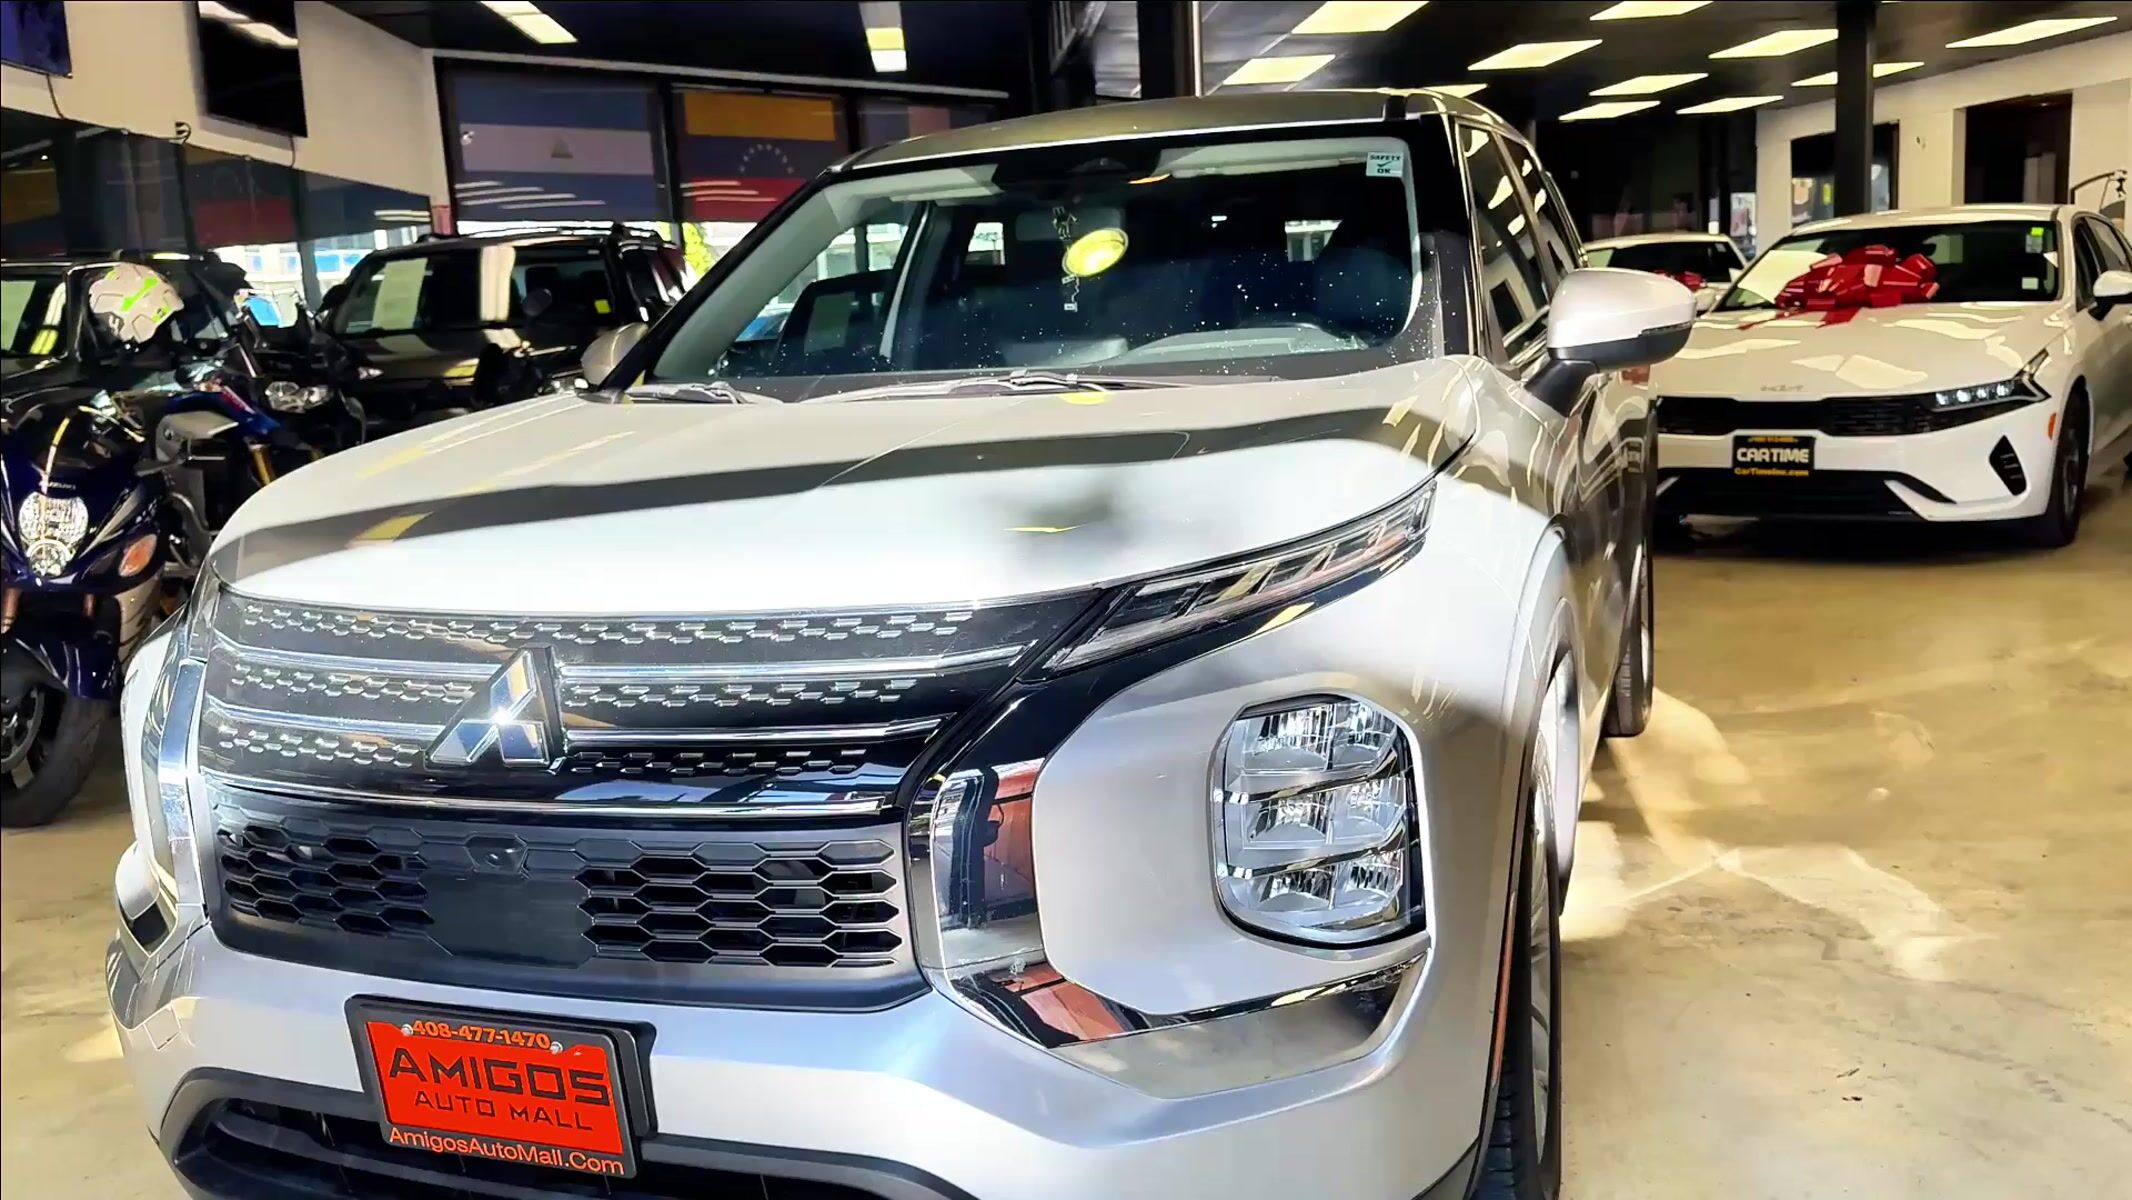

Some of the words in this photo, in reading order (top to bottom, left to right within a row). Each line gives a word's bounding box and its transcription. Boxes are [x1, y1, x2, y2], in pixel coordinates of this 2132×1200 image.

[1736, 448, 1810, 463] CARTIME
[412, 1019, 551, 1049] 408-477-1470
[389, 1048, 611, 1106] AMIGOS
[414, 1090, 496, 1118] AUTO
[510, 1103, 593, 1131] MALL
[389, 1126, 625, 1176] AmigosAutoMall.Com
